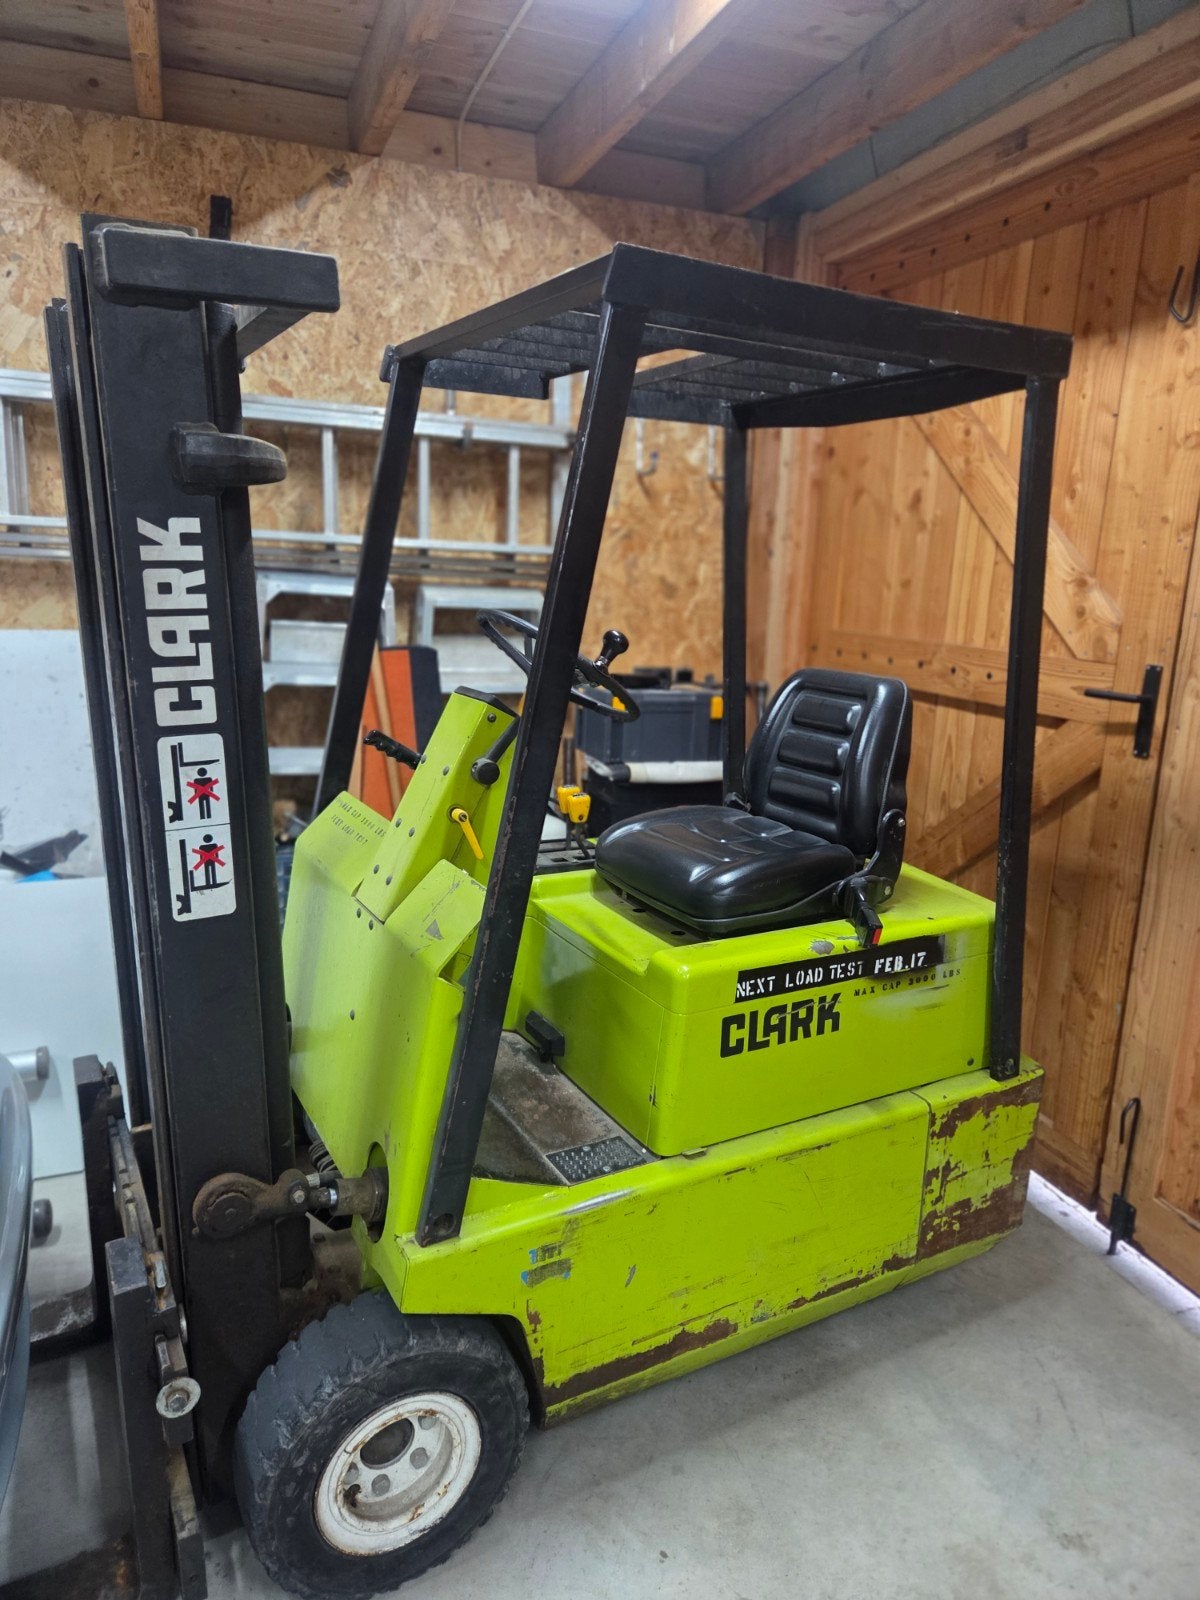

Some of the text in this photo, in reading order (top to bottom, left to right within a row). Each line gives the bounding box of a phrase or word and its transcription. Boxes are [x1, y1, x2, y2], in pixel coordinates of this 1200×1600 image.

[136, 516, 218, 727] CLARK
[736, 952, 927, 998] NEXT LOAD TEST FEB.17
[854, 969, 961, 997] MAX CAP 3000 LBS
[719, 992, 842, 1059] CLARK
